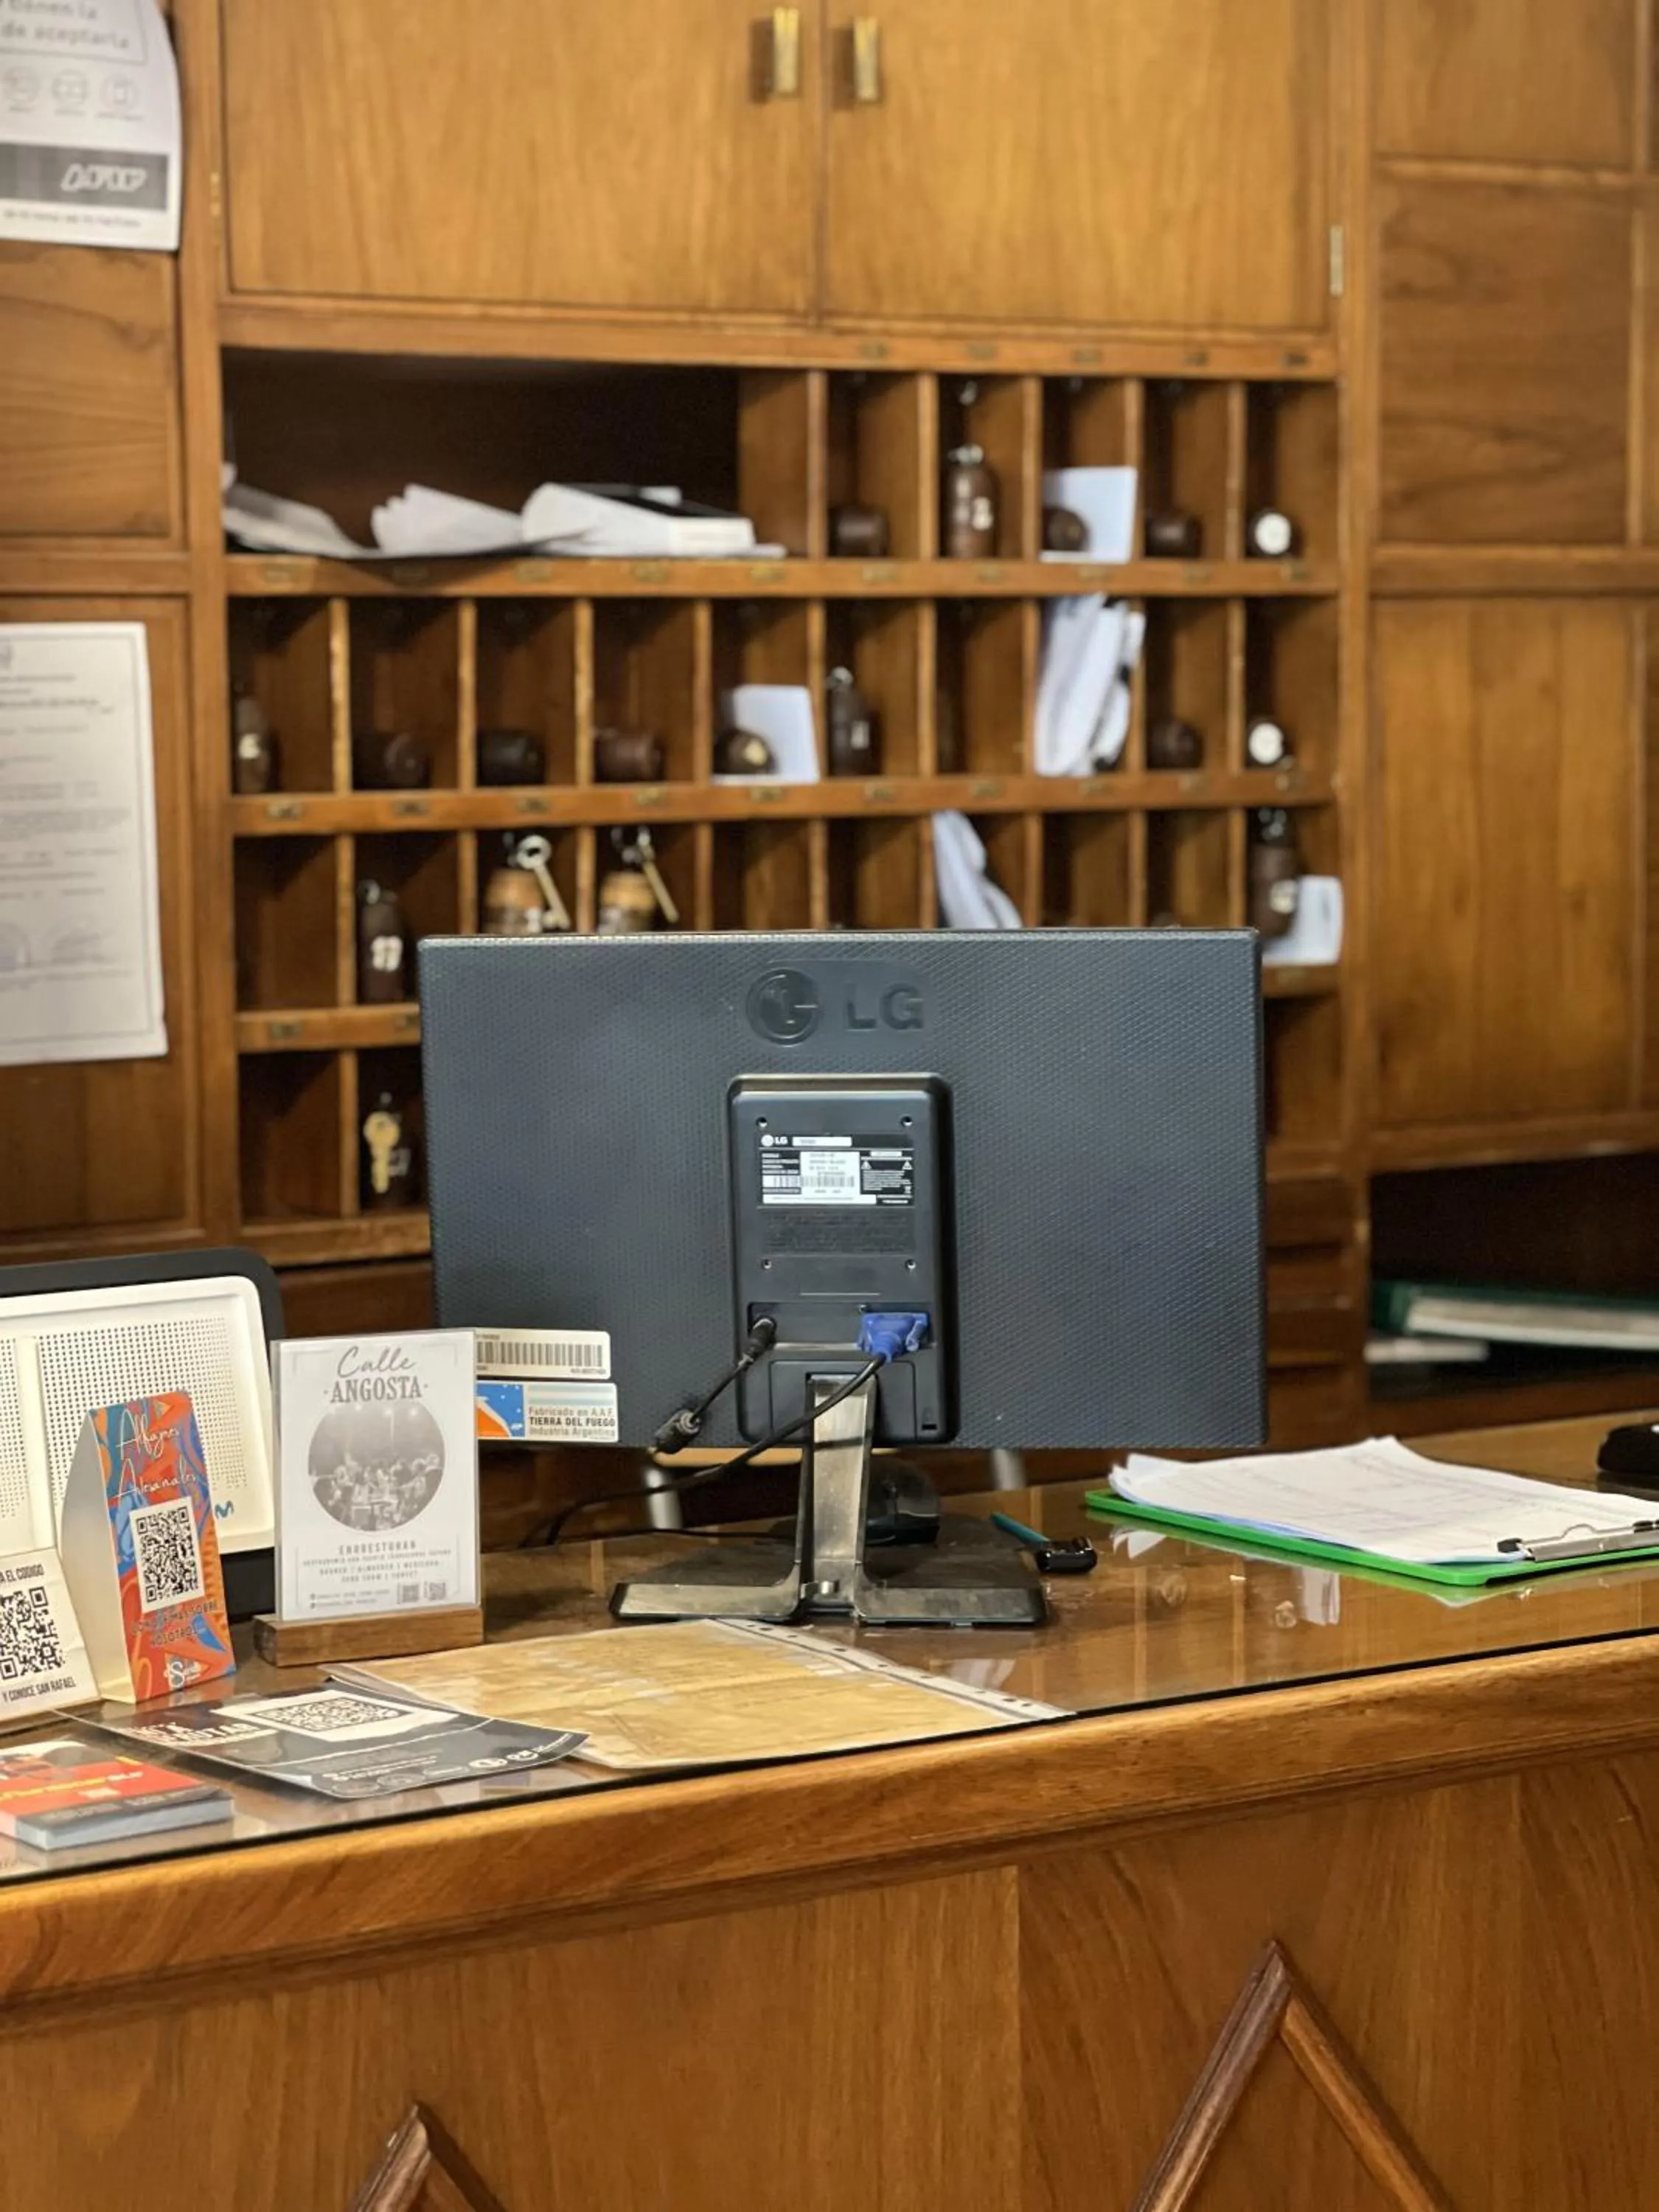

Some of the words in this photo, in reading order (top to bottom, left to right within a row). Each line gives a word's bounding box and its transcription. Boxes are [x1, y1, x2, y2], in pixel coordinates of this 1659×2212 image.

[846, 985, 926, 1030] LG
[774, 1135, 788, 1145] LG
[337, 1346, 416, 1378] Calle
[330, 1376, 422, 1402] ANGOSTA
[529, 1405, 574, 1416] Fabricado
[578, 1408, 589, 1416] en
[529, 1417, 562, 1426] TIERRA
[566, 1417, 582, 1426] DEL
[585, 1417, 616, 1427] FUEGO
[529, 1427, 570, 1436] Industria
[8, 1685, 35, 1702] CONOCE
[35, 1682, 50, 1695] SAN
[49, 1676, 77, 1691] RAFAEL
